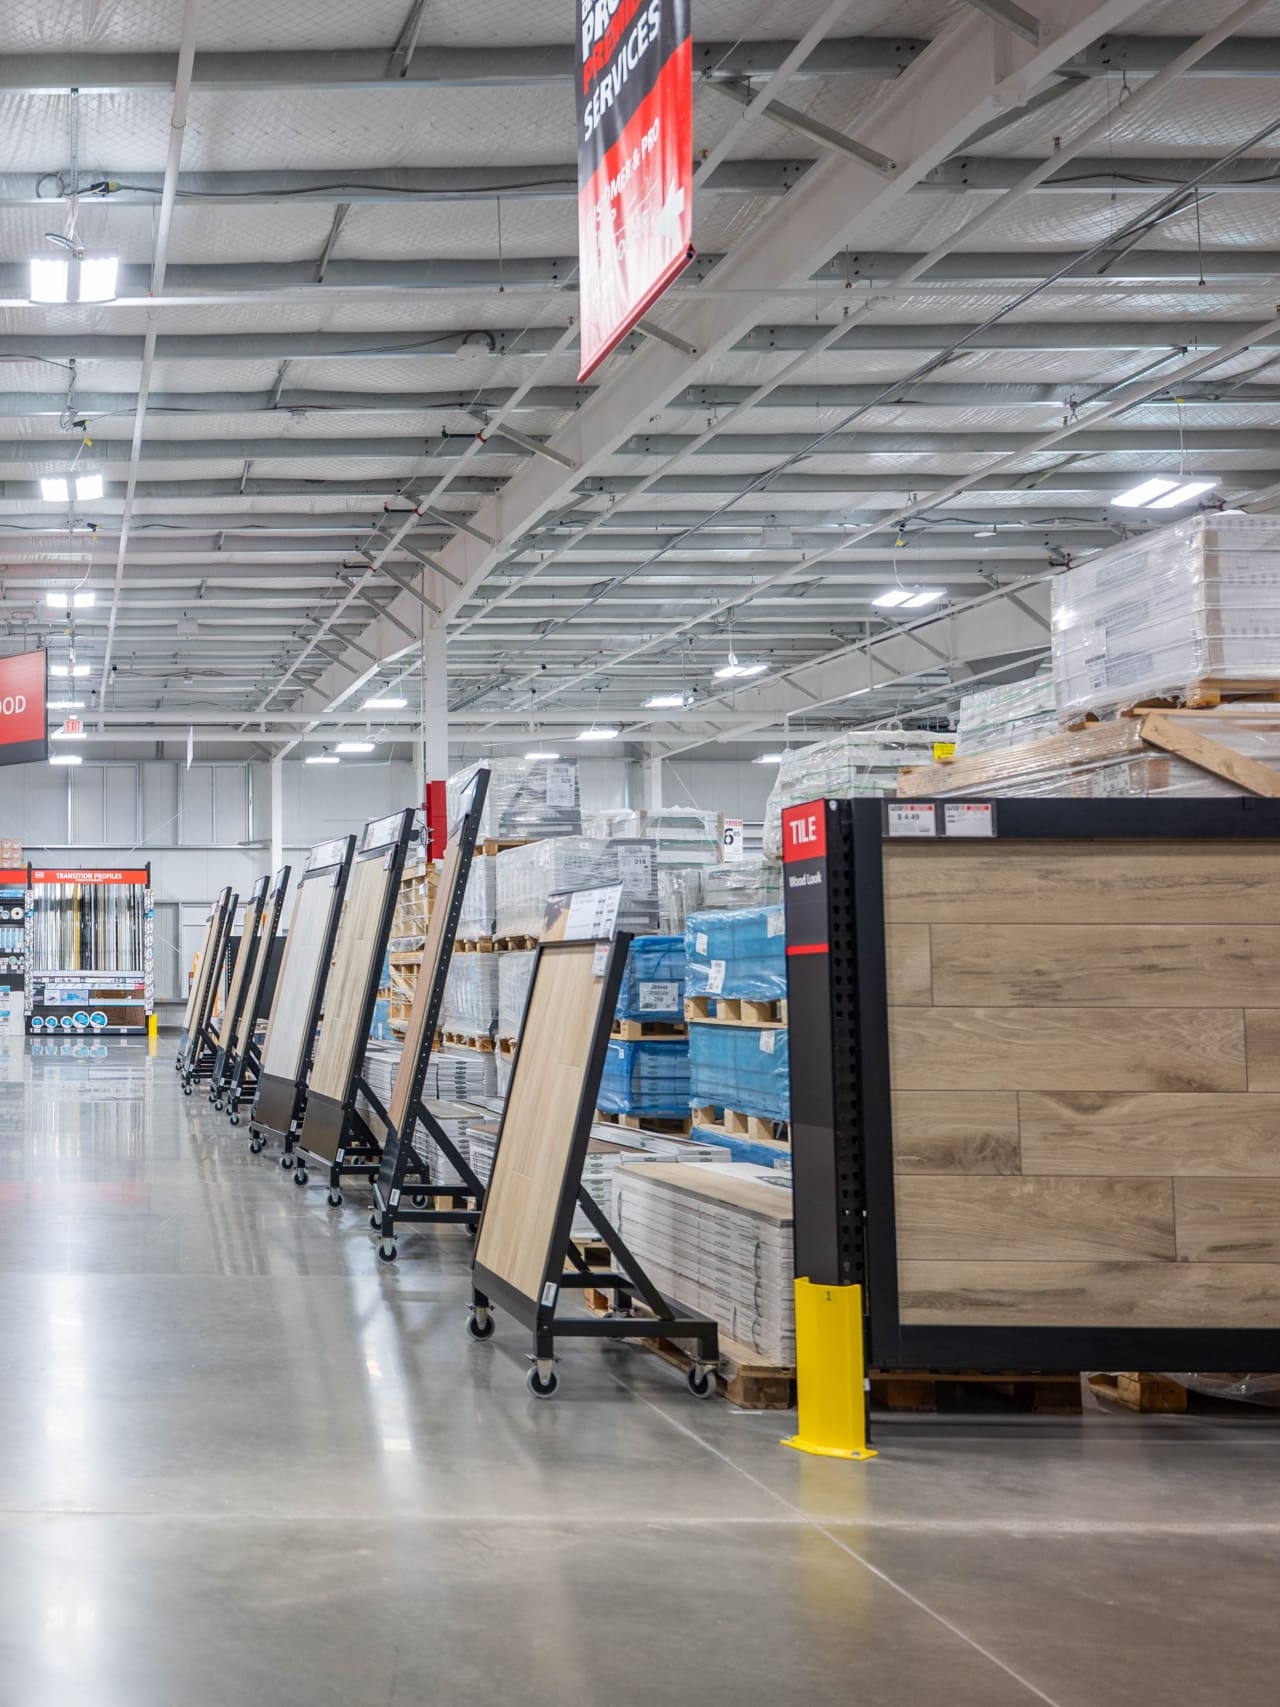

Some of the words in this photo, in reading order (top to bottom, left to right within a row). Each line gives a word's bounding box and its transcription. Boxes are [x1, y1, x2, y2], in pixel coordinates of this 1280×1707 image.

[584, 0, 661, 142] SERVICES
[641, 116, 661, 160] PRO
[66, 720, 81, 732] EXIT
[723, 828, 734, 845] 6
[789, 816, 817, 845] TILE
[789, 875, 807, 888] Wood
[806, 871, 822, 885] Look
